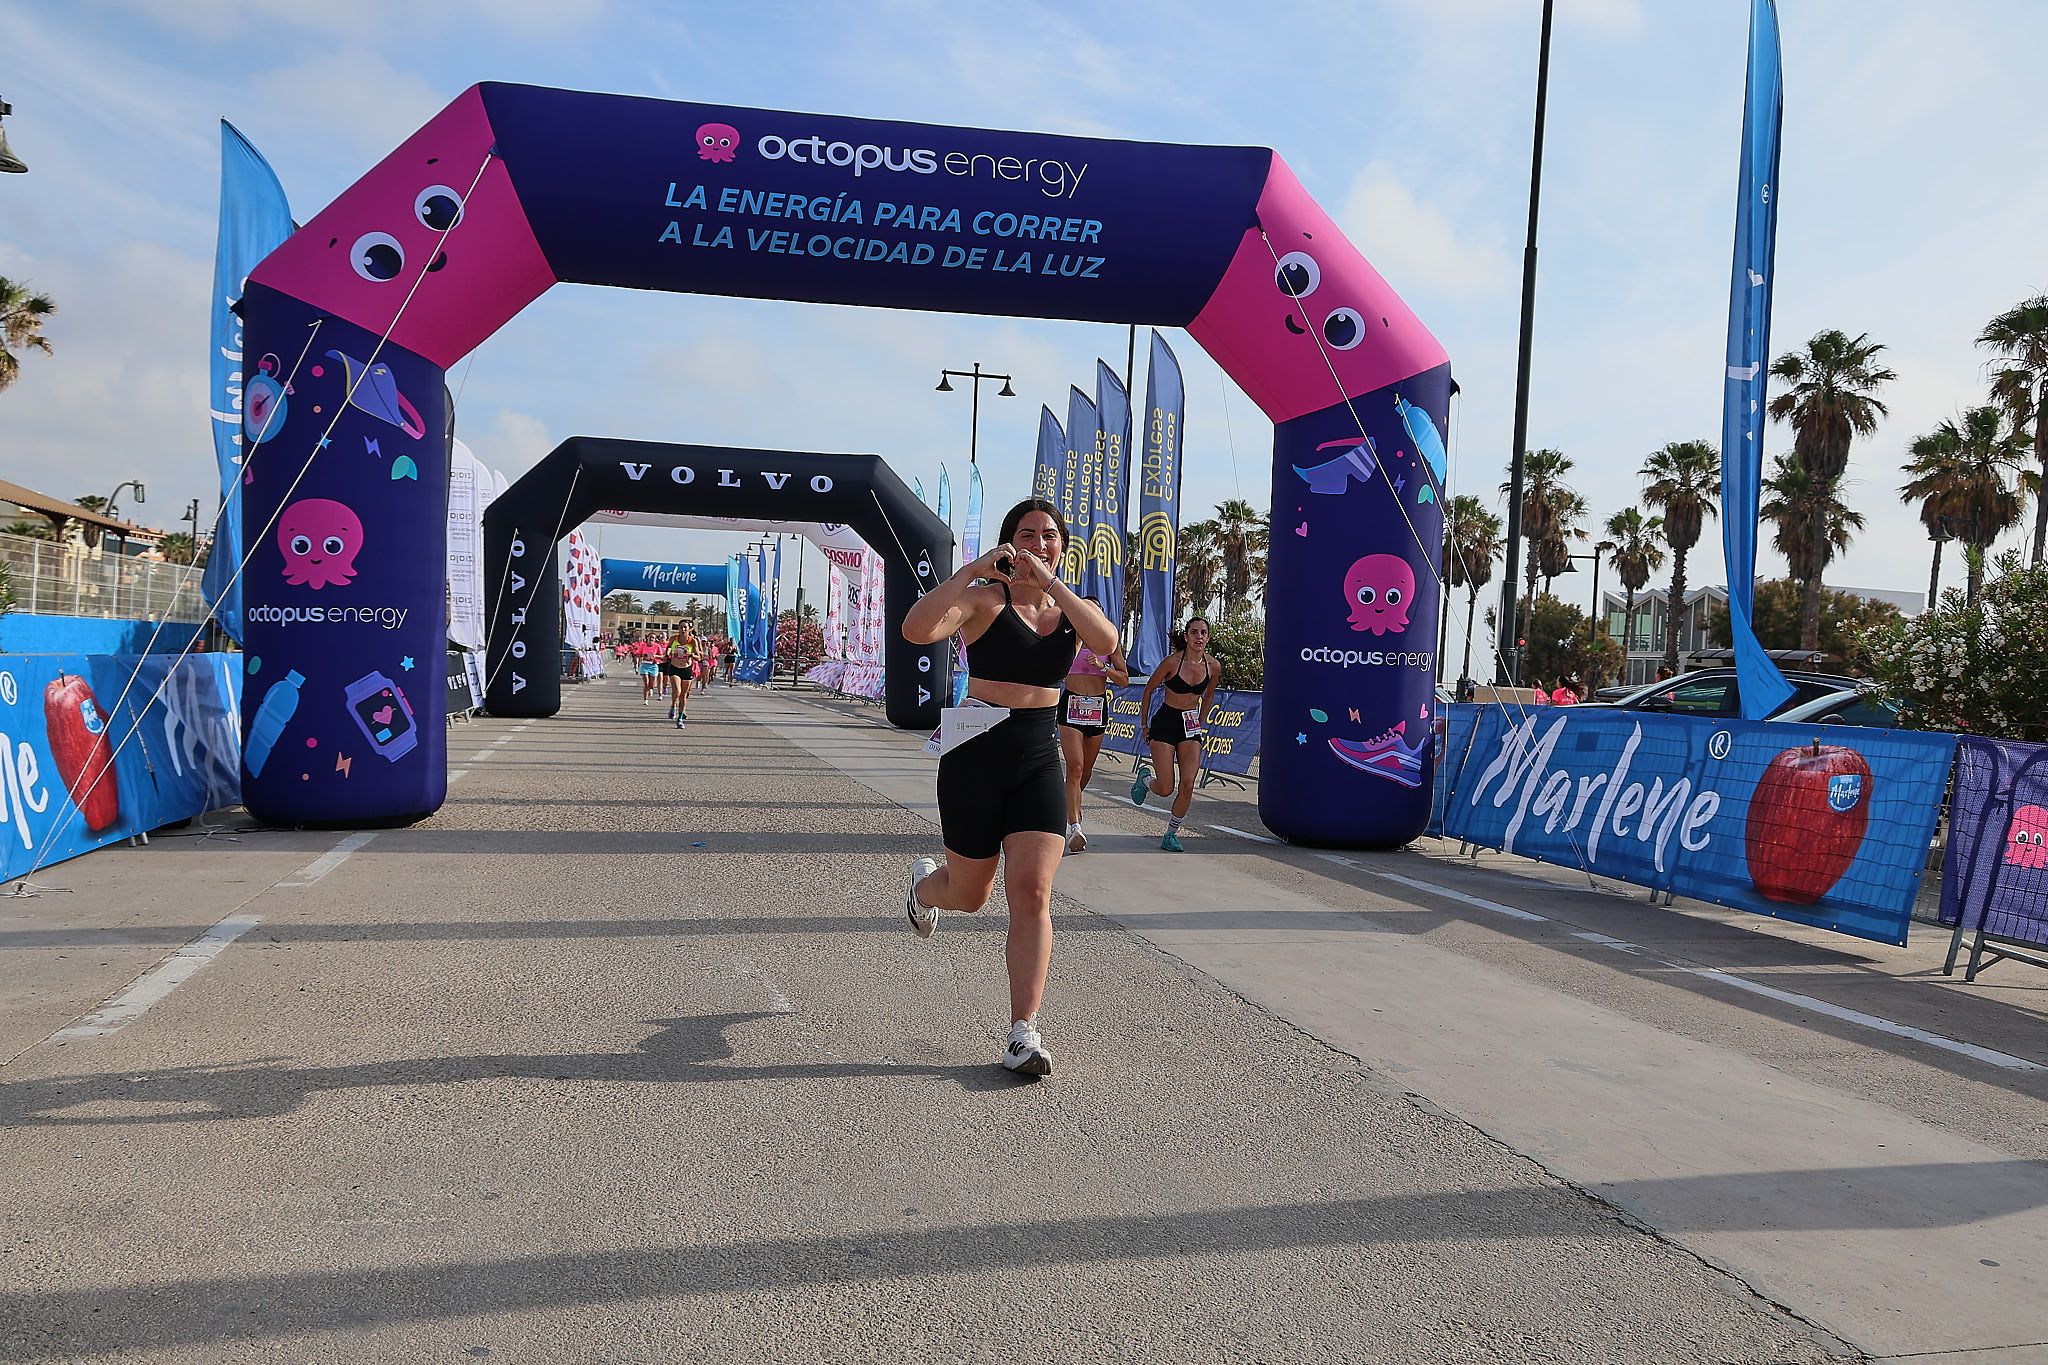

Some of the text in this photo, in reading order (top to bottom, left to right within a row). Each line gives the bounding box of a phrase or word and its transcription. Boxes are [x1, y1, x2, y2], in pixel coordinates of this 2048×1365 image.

[758, 133, 1088, 198] octopus energy
[664, 182, 1104, 244] LA ENERGÍA PARA CORRER
[658, 220, 1106, 279] A LA VELOCIDAD DE LA LUZ
[619, 461, 834, 493] VOLVO
[823, 547, 862, 568] COSMO
[642, 564, 697, 588] Marlene
[248, 604, 408, 630] octopus energy
[511, 539, 527, 695] VOLVO
[1300, 646, 1434, 672] octopus energy
[1112, 696, 1142, 715] Correos
[1206, 704, 1245, 727] Correos
[1104, 717, 1136, 741] Express
[1471, 715, 1722, 873] Marlene
